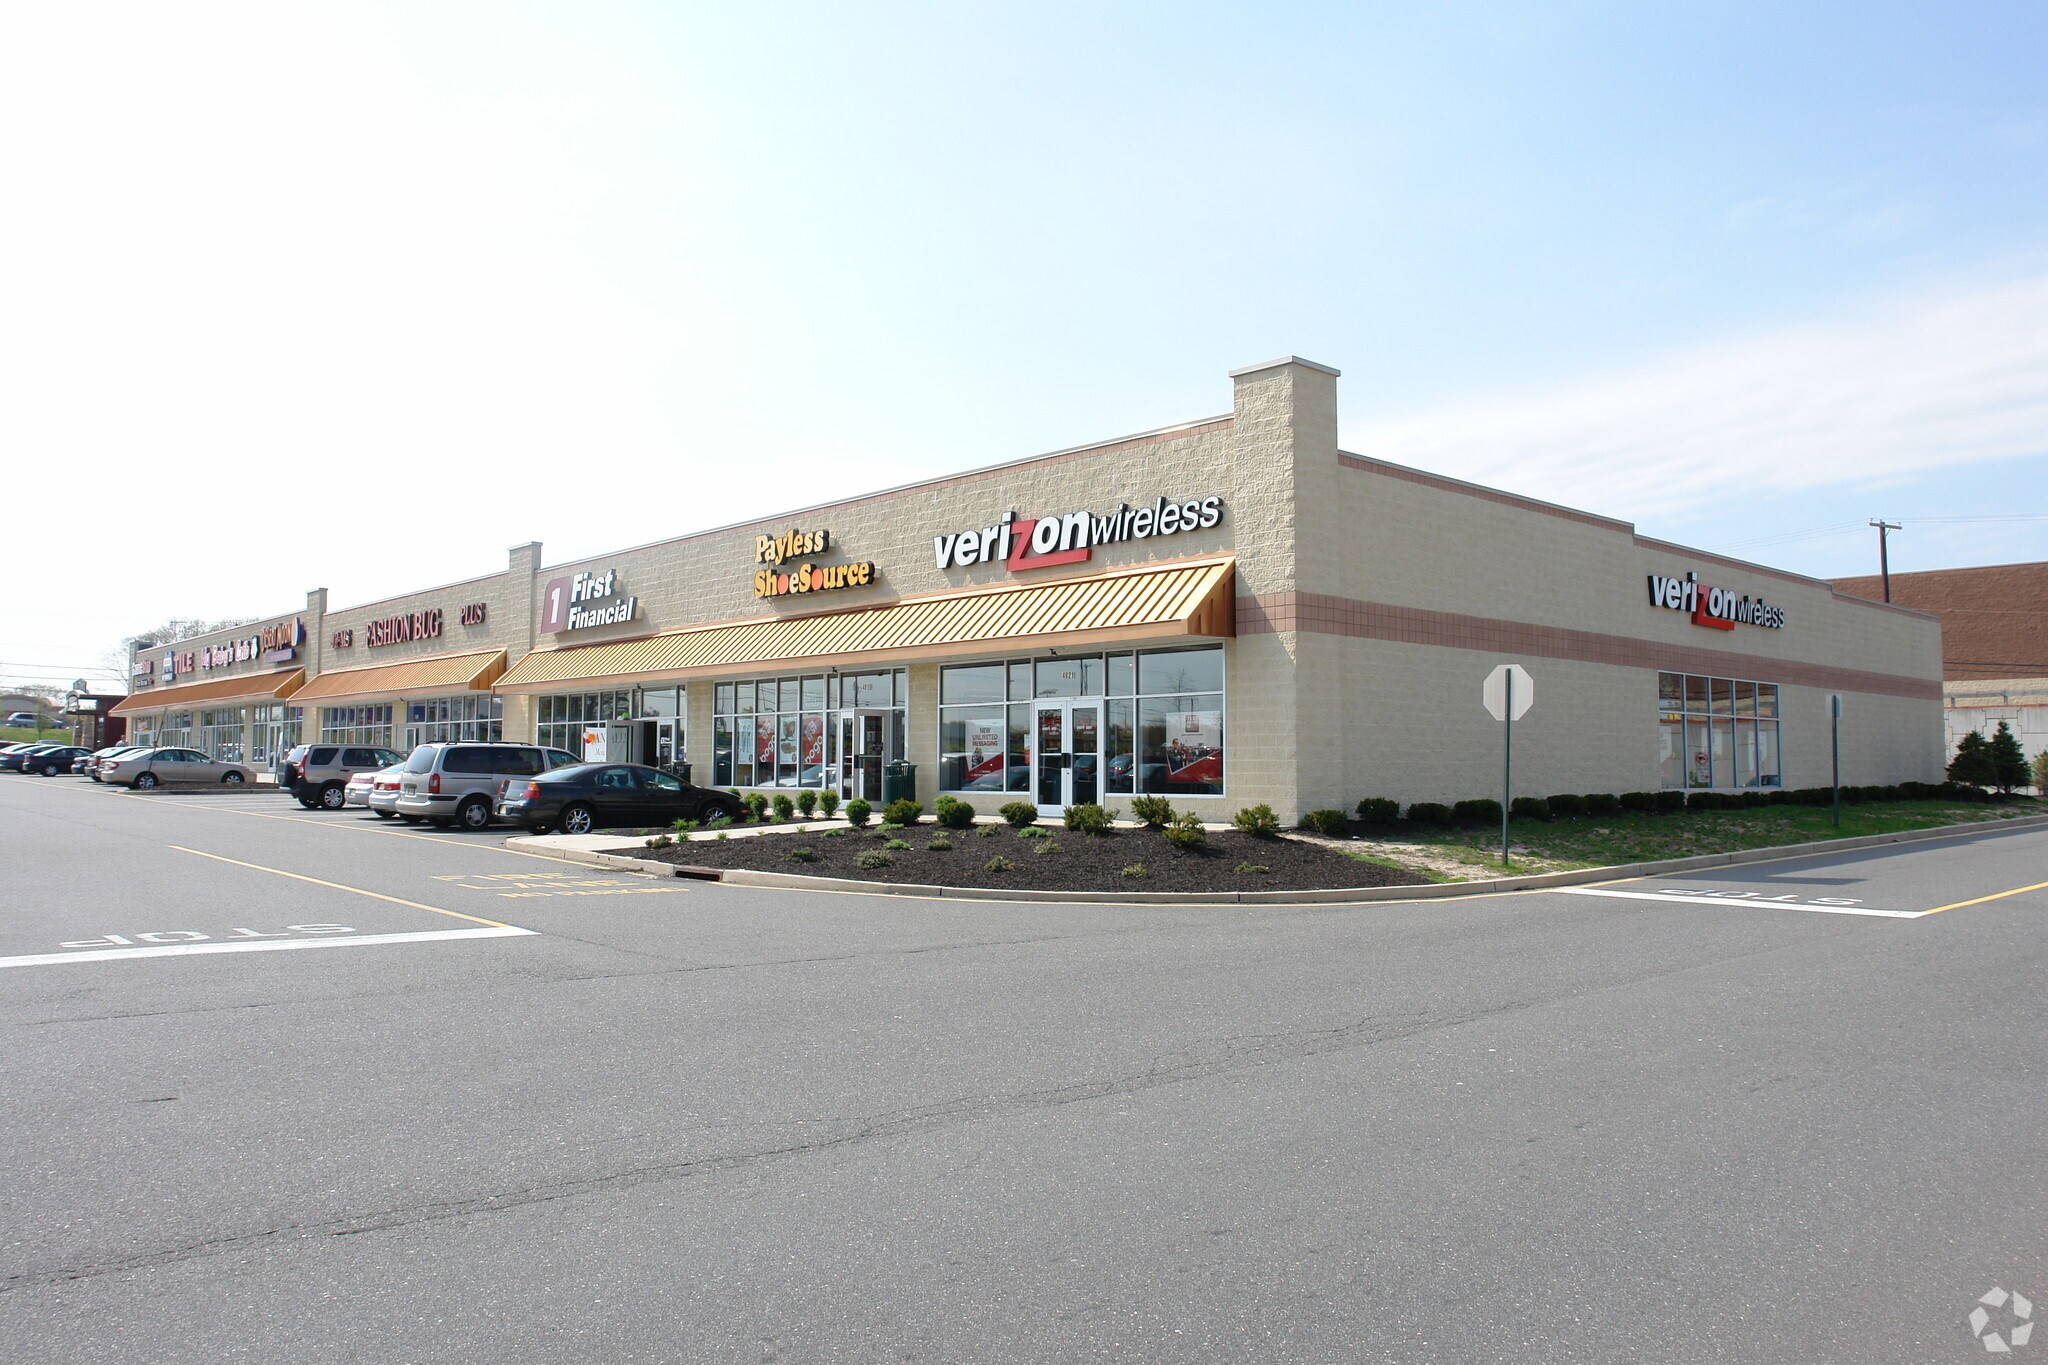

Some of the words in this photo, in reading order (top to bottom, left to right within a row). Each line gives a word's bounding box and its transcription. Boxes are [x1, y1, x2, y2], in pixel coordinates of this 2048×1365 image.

[755, 528, 830, 565] Payless
[933, 510, 1092, 572] verizon
[1091, 496, 1223, 546] wireless
[571, 568, 616, 603] First
[754, 560, 875, 599] ShoeSource
[460, 603, 486, 625] PLUS
[567, 597, 637, 631] Financial
[1647, 572, 1735, 631] verizon
[1735, 595, 1785, 629] wireless
[365, 613, 411, 648] FASHION
[413, 608, 442, 640] BUG
[173, 652, 193, 674] TILE
[428, 872, 581, 881] FIRE
[456, 879, 640, 889] LANE
[1658, 887, 1863, 905] STOP
[59, 922, 357, 950] STOP
